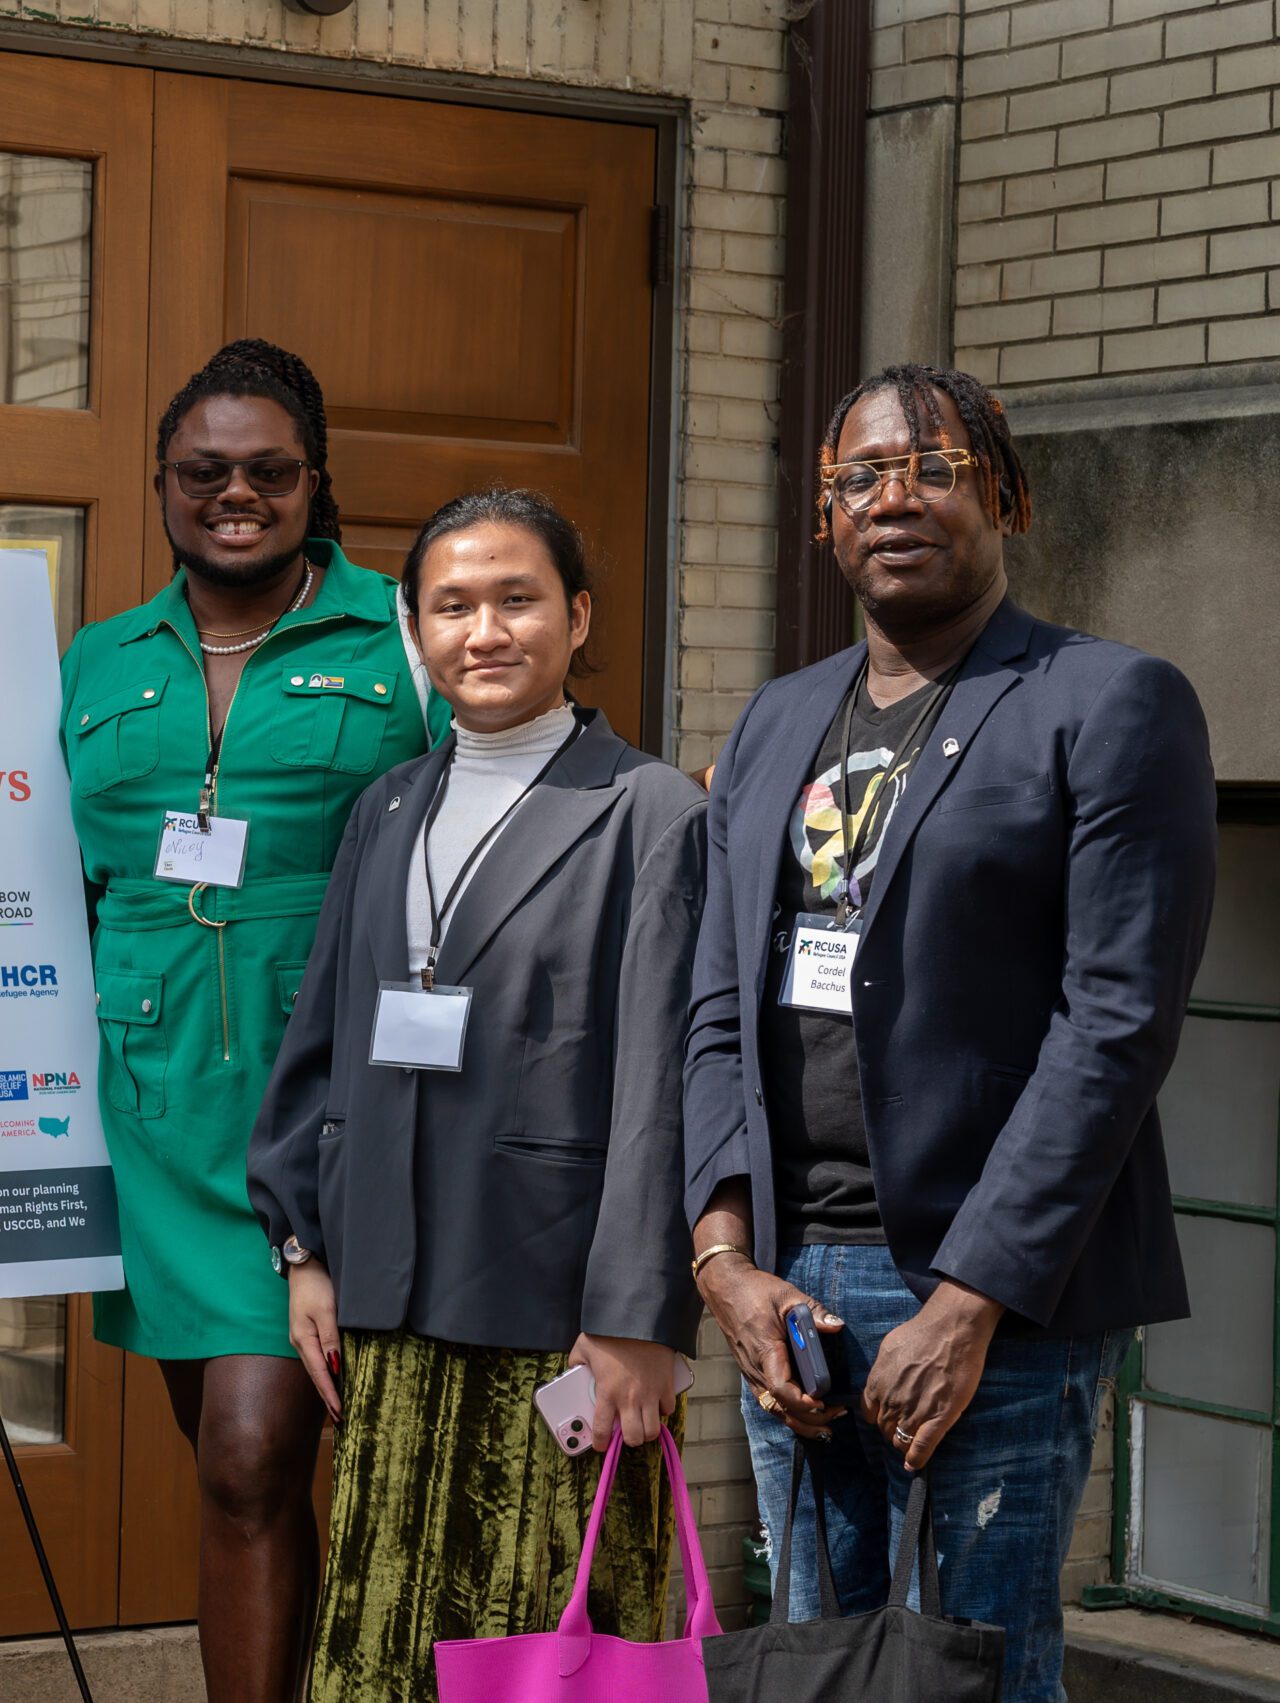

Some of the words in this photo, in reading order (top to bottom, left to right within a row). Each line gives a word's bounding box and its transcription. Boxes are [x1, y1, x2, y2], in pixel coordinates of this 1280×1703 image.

[179, 818, 212, 831] RCU
[814, 941, 847, 954] RCUSA
[817, 964, 846, 976] Cordel
[810, 979, 846, 992] Bacchus
[30, 988, 59, 998] Agency
[32, 1071, 81, 1087] NPNA
[1, 1129, 36, 1138] AMERICA
[11, 1186, 31, 1197] our
[32, 1183, 80, 1197] planning
[25, 1200, 59, 1214] Rights
[61, 1199, 88, 1211] First,
[3, 1218, 44, 1232] USCCB,
[46, 1216, 67, 1228] and
[68, 1216, 86, 1227] We
